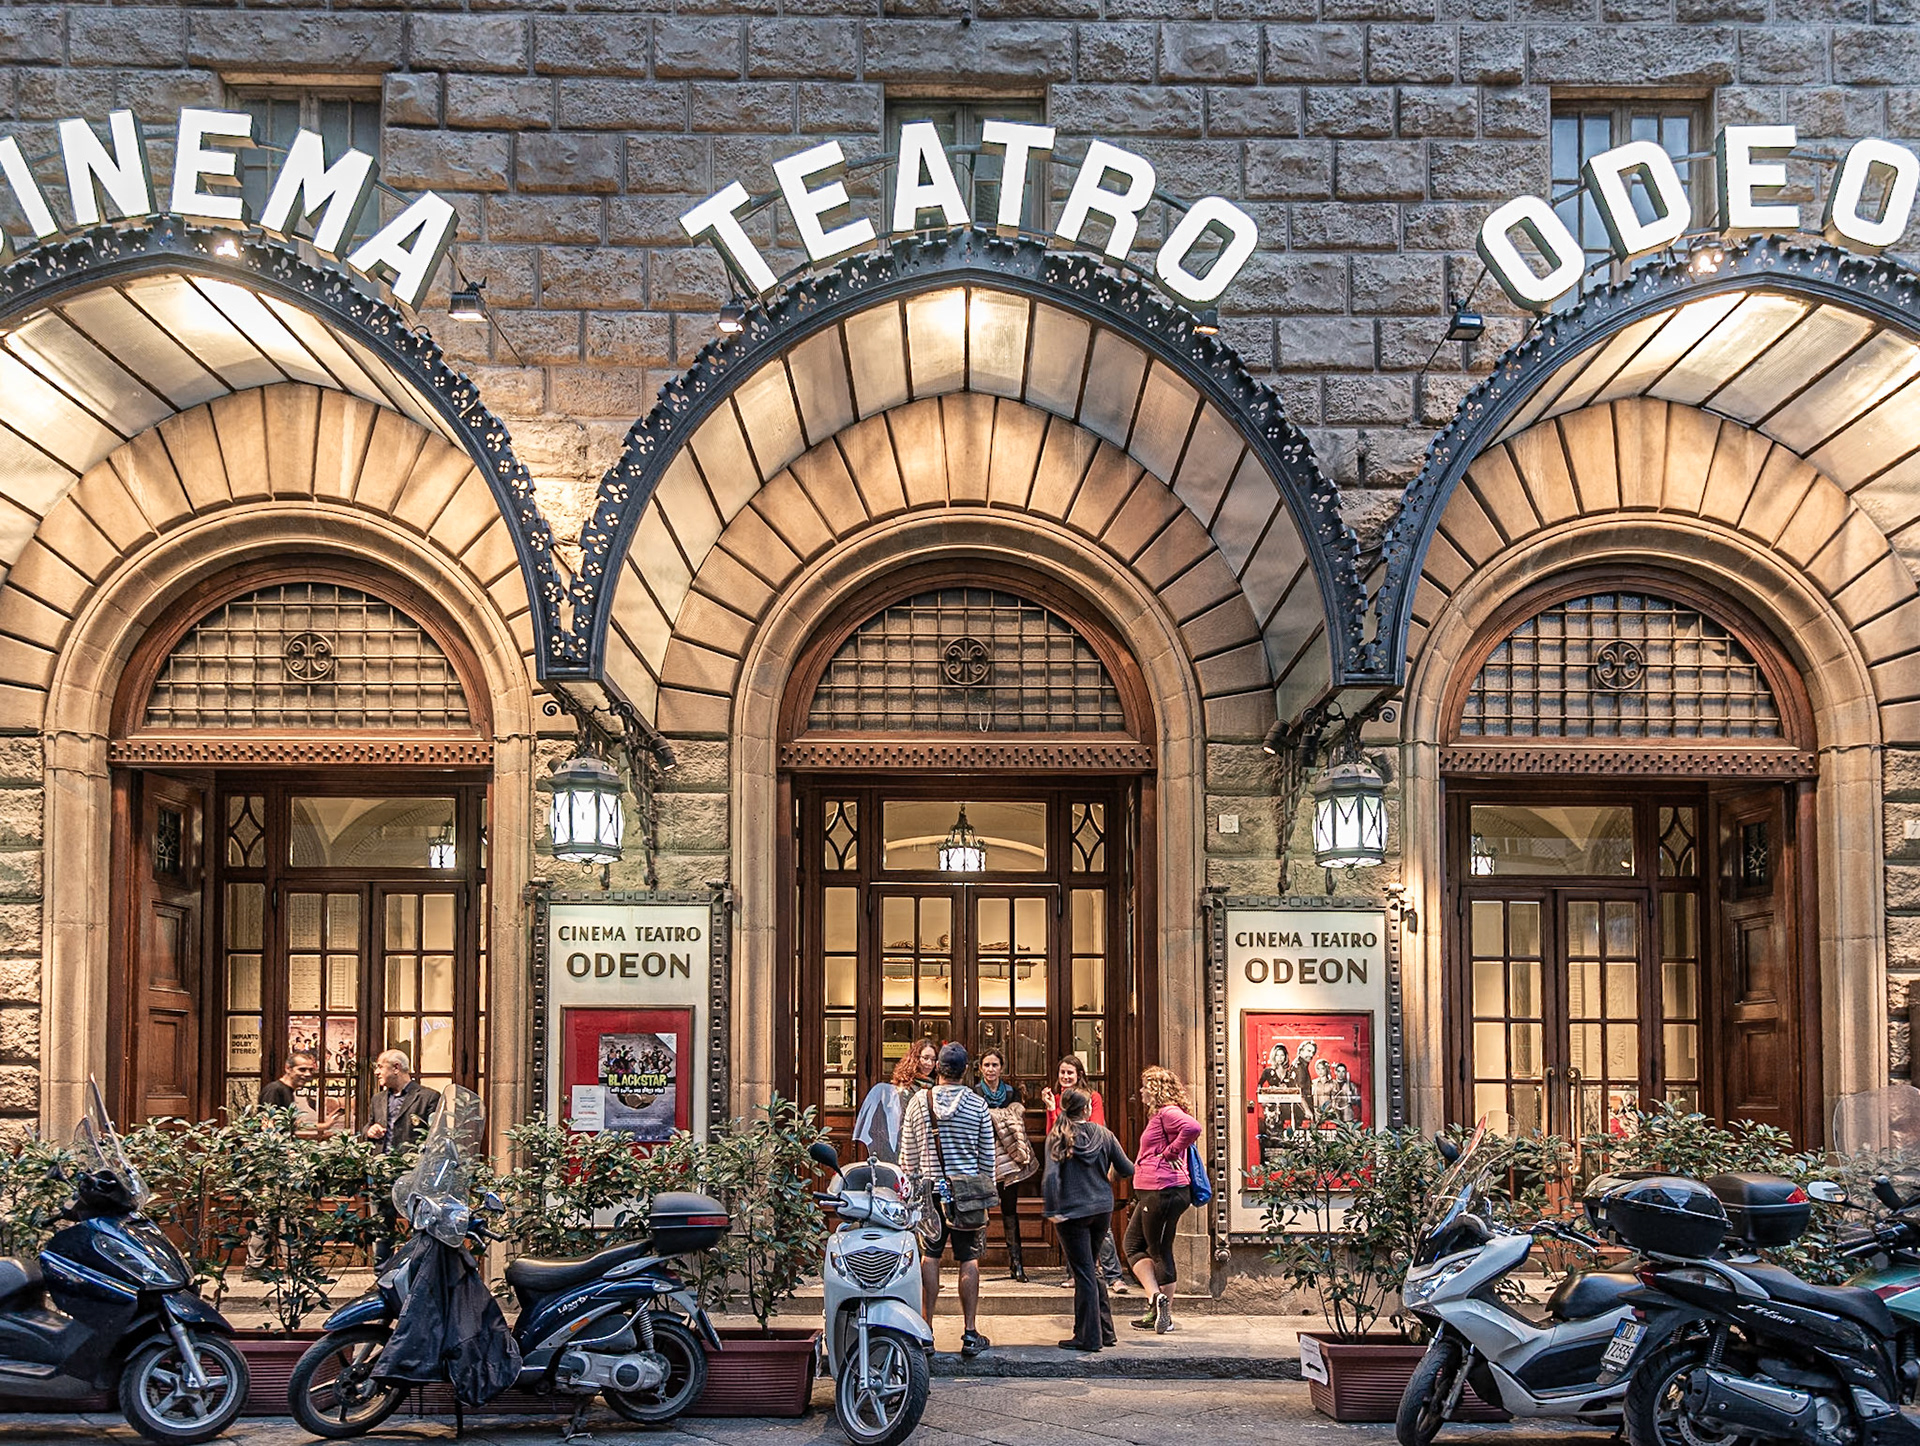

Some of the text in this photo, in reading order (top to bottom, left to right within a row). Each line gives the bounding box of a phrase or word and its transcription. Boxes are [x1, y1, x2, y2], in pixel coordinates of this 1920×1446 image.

[0, 108, 458, 307] INEMA
[679, 119, 1259, 304] TEATRO
[558, 925, 702, 942] CINEMA TEATRO
[1235, 932, 1377, 948] CINEMA TEATRO
[566, 952, 690, 979] ODEON
[1244, 957, 1368, 984] ODEON
[608, 1073, 668, 1087] BLACKSTAR
